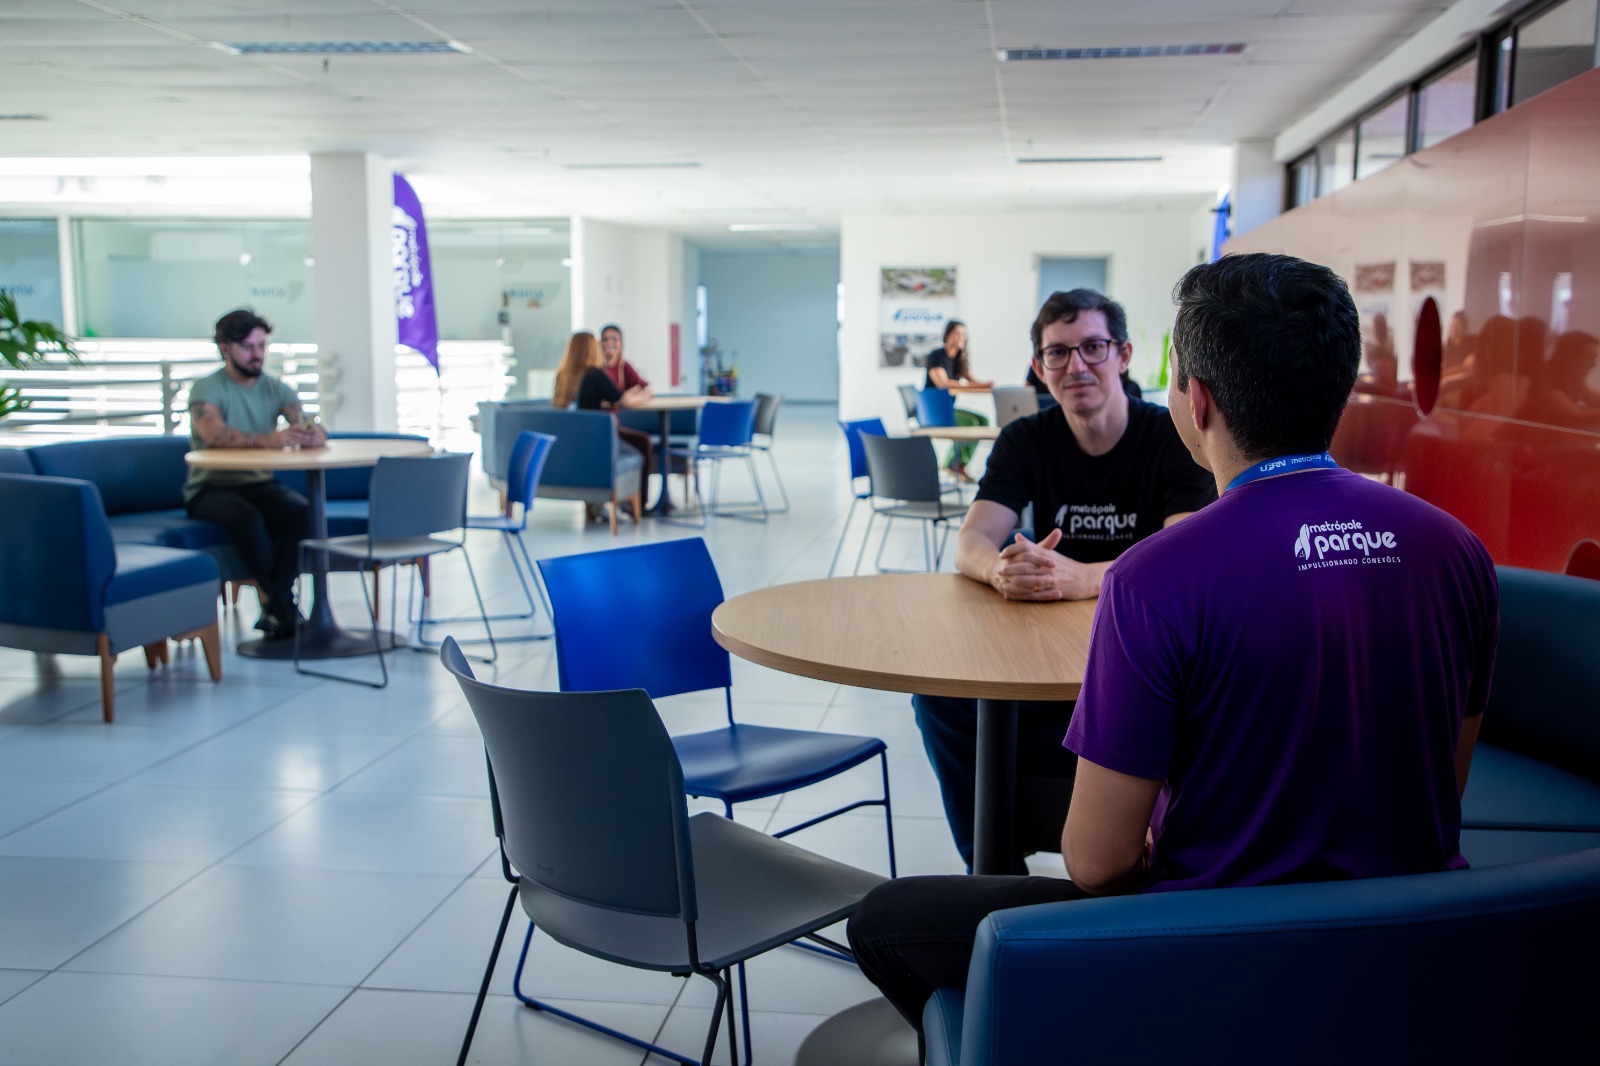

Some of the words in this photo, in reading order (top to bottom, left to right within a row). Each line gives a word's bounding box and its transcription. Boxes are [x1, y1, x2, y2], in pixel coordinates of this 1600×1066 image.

[1070, 503, 1116, 514] metrópole
[1070, 513, 1137, 535] parque
[1309, 519, 1363, 533] metrópole
[1314, 531, 1398, 560] parque
[1297, 558, 1358, 571] IMPULSIONANDO
[1361, 556, 1401, 564] CONEXÕES
